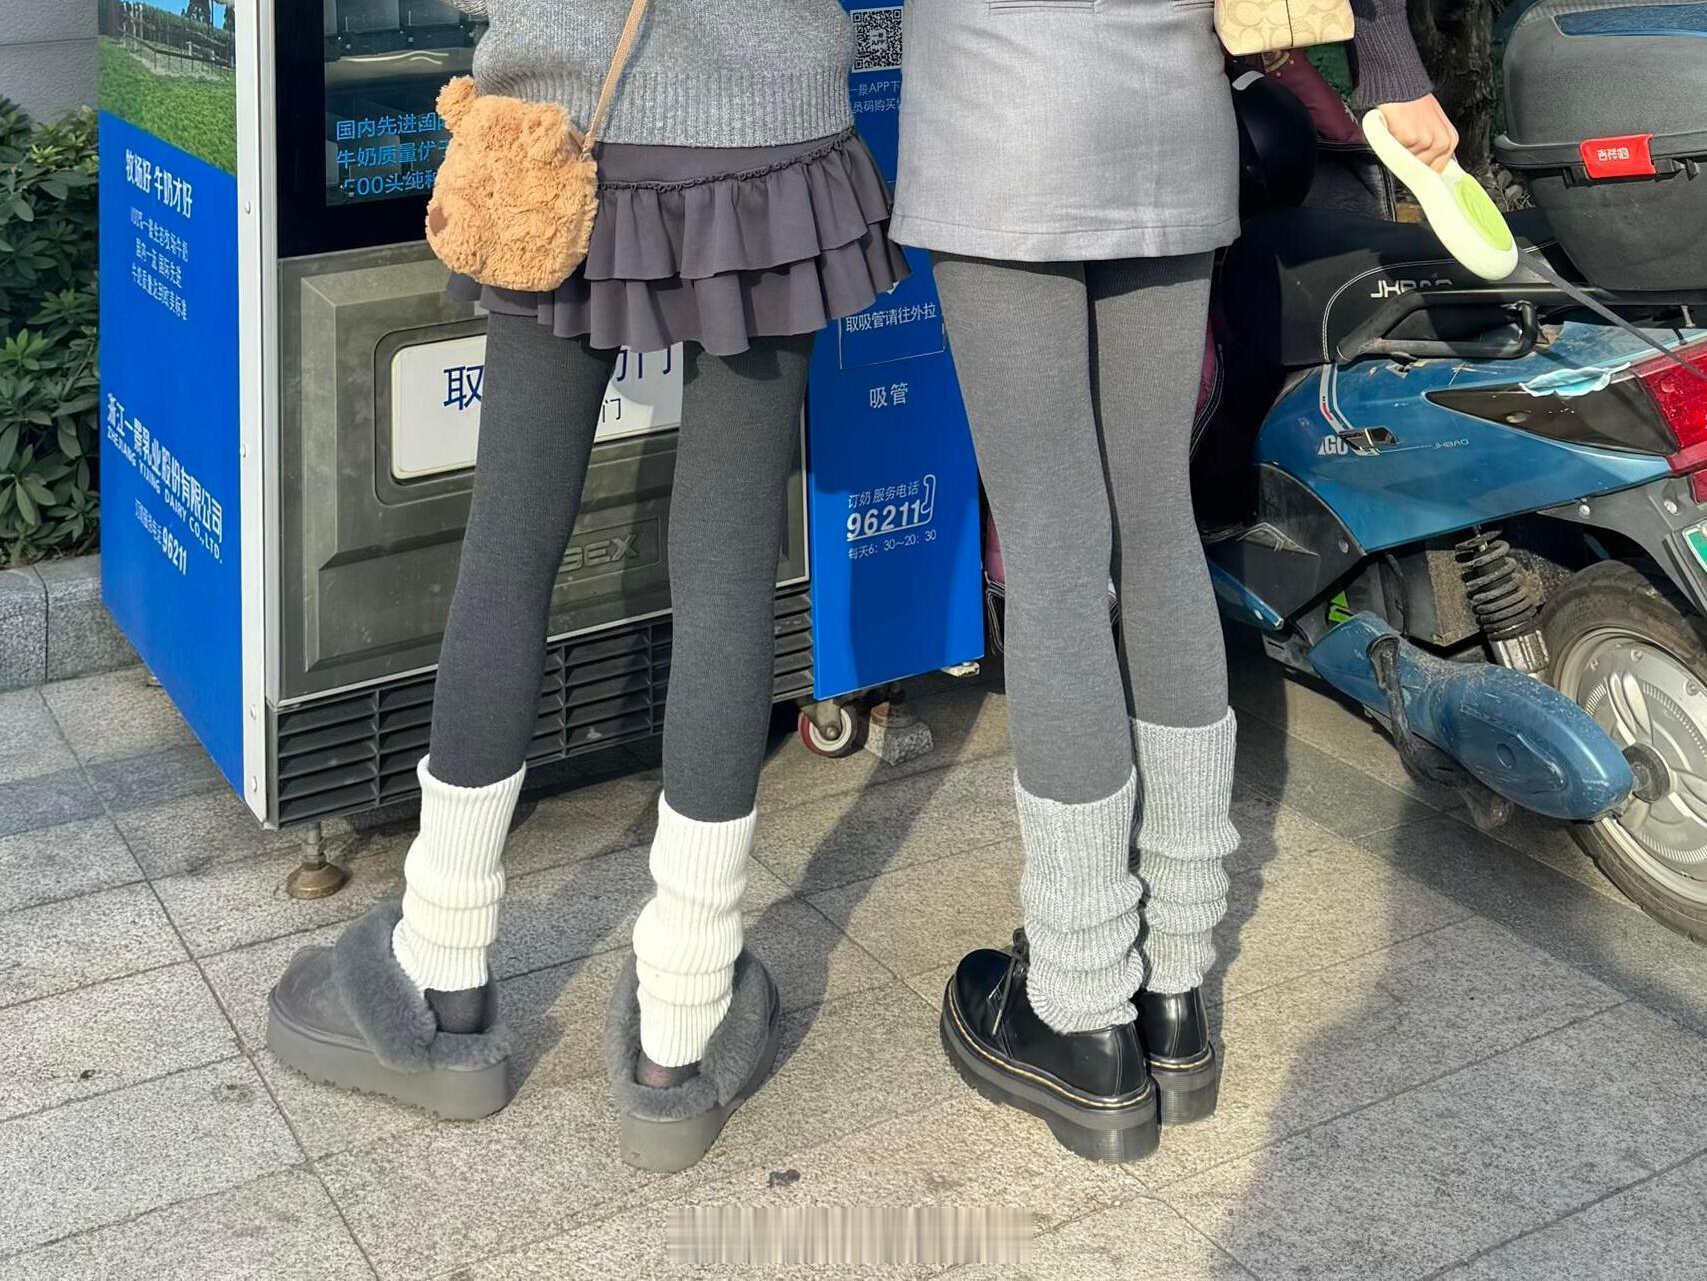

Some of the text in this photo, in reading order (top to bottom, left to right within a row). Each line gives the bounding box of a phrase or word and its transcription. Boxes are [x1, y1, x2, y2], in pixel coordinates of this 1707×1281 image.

[853, 98, 900, 113] 员码购买
[125, 148, 193, 219] 牧场好 牛奶才好
[846, 302, 937, 333] 取吸管请往外拉
[869, 382, 908, 409] 吸管
[107, 393, 223, 544] 浙江一景乳业股份有限公司
[164, 488, 187, 522] DAIRY
[848, 480, 920, 509] 订奶 服务电话
[846, 499, 921, 539] 96211
[161, 526, 188, 576] 96211
